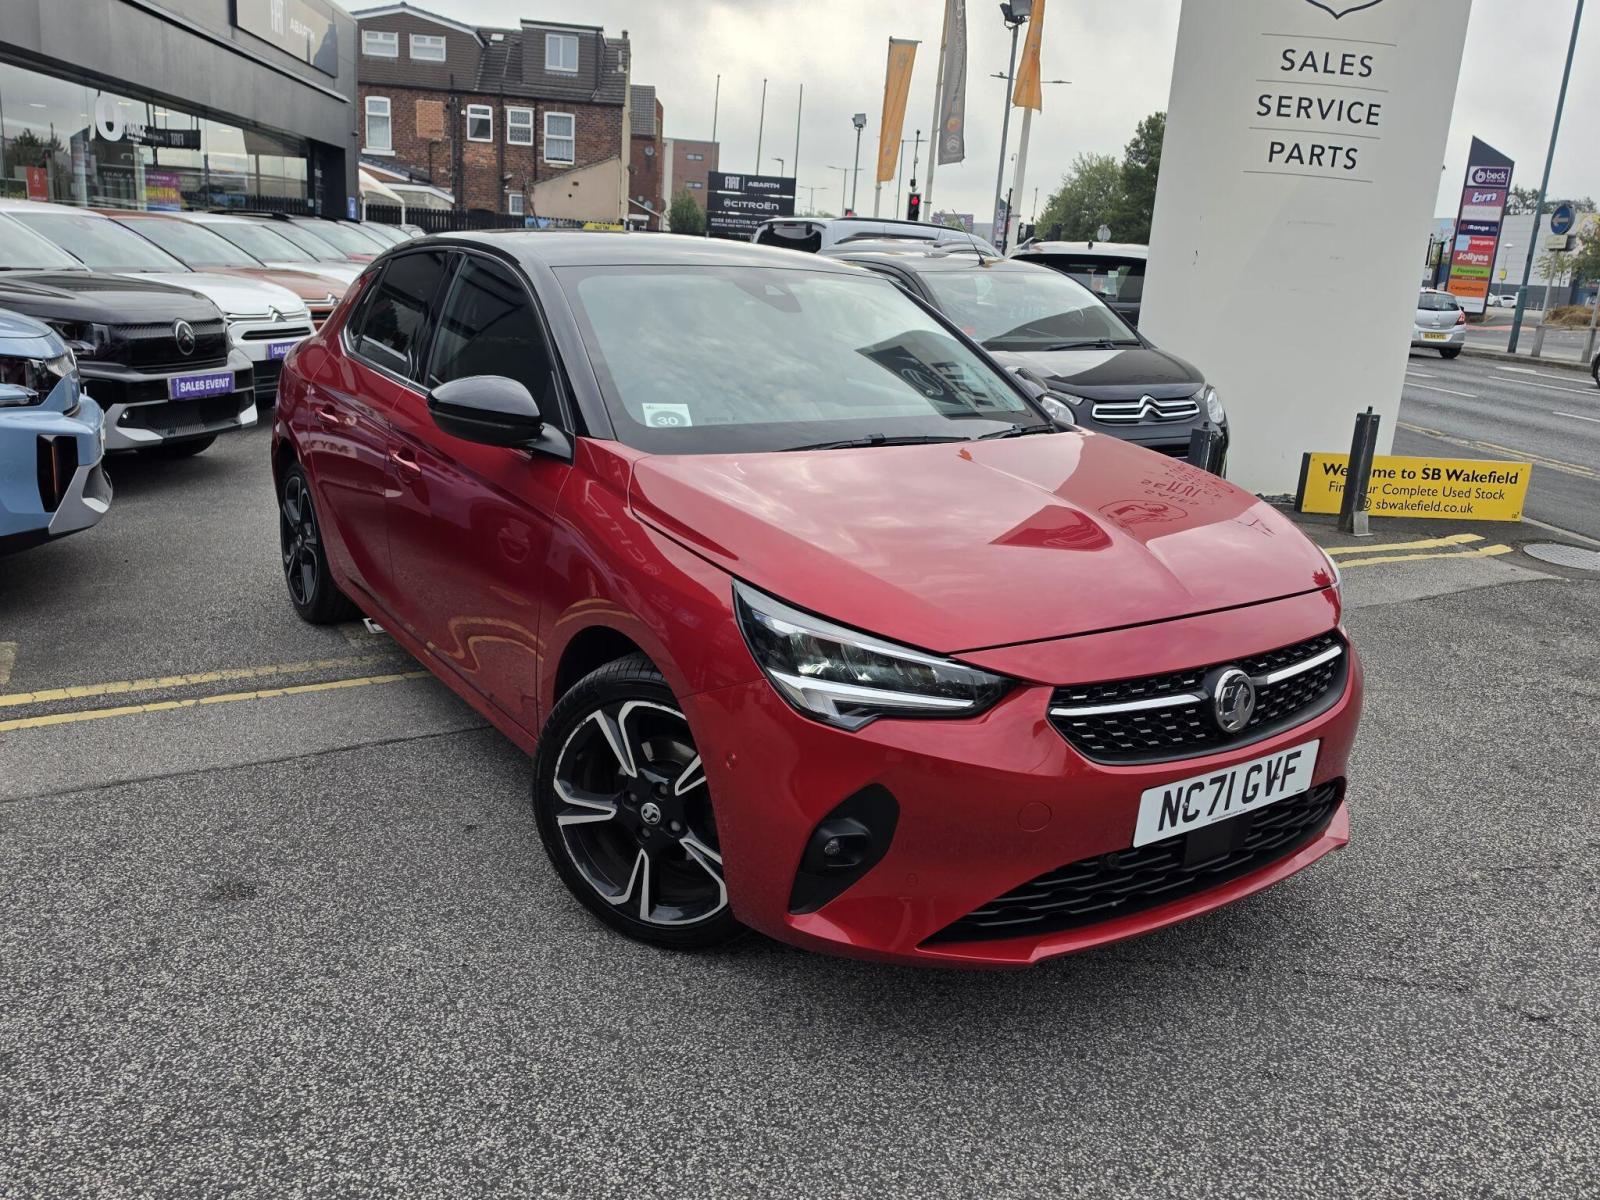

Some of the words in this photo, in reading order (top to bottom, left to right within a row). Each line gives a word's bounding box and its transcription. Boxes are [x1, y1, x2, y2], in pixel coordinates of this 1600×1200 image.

[1280, 48, 1374, 78] SALES
[1256, 94, 1381, 126] SERVICE
[1268, 141, 1359, 170] PARTS
[725, 176, 741, 190] FIAT
[747, 181, 780, 189] ABARTH
[1457, 252, 1489, 262] Jollyes
[180, 380, 205, 393] SALES
[205, 378, 229, 390] EVENT
[657, 416, 679, 426] 30
[1323, 462, 1396, 479] Weme
[1401, 468, 1416, 479] to
[1421, 467, 1441, 480] SB
[1446, 468, 1518, 484] Wakefield
[1382, 483, 1438, 498] Complete
[1442, 486, 1472, 498] Used
[1475, 488, 1505, 500] Stock
[1376, 498, 1473, 514] sbwakefield.co.uk
[1158, 771, 1237, 832] NC71
[1241, 750, 1302, 805] GVF
